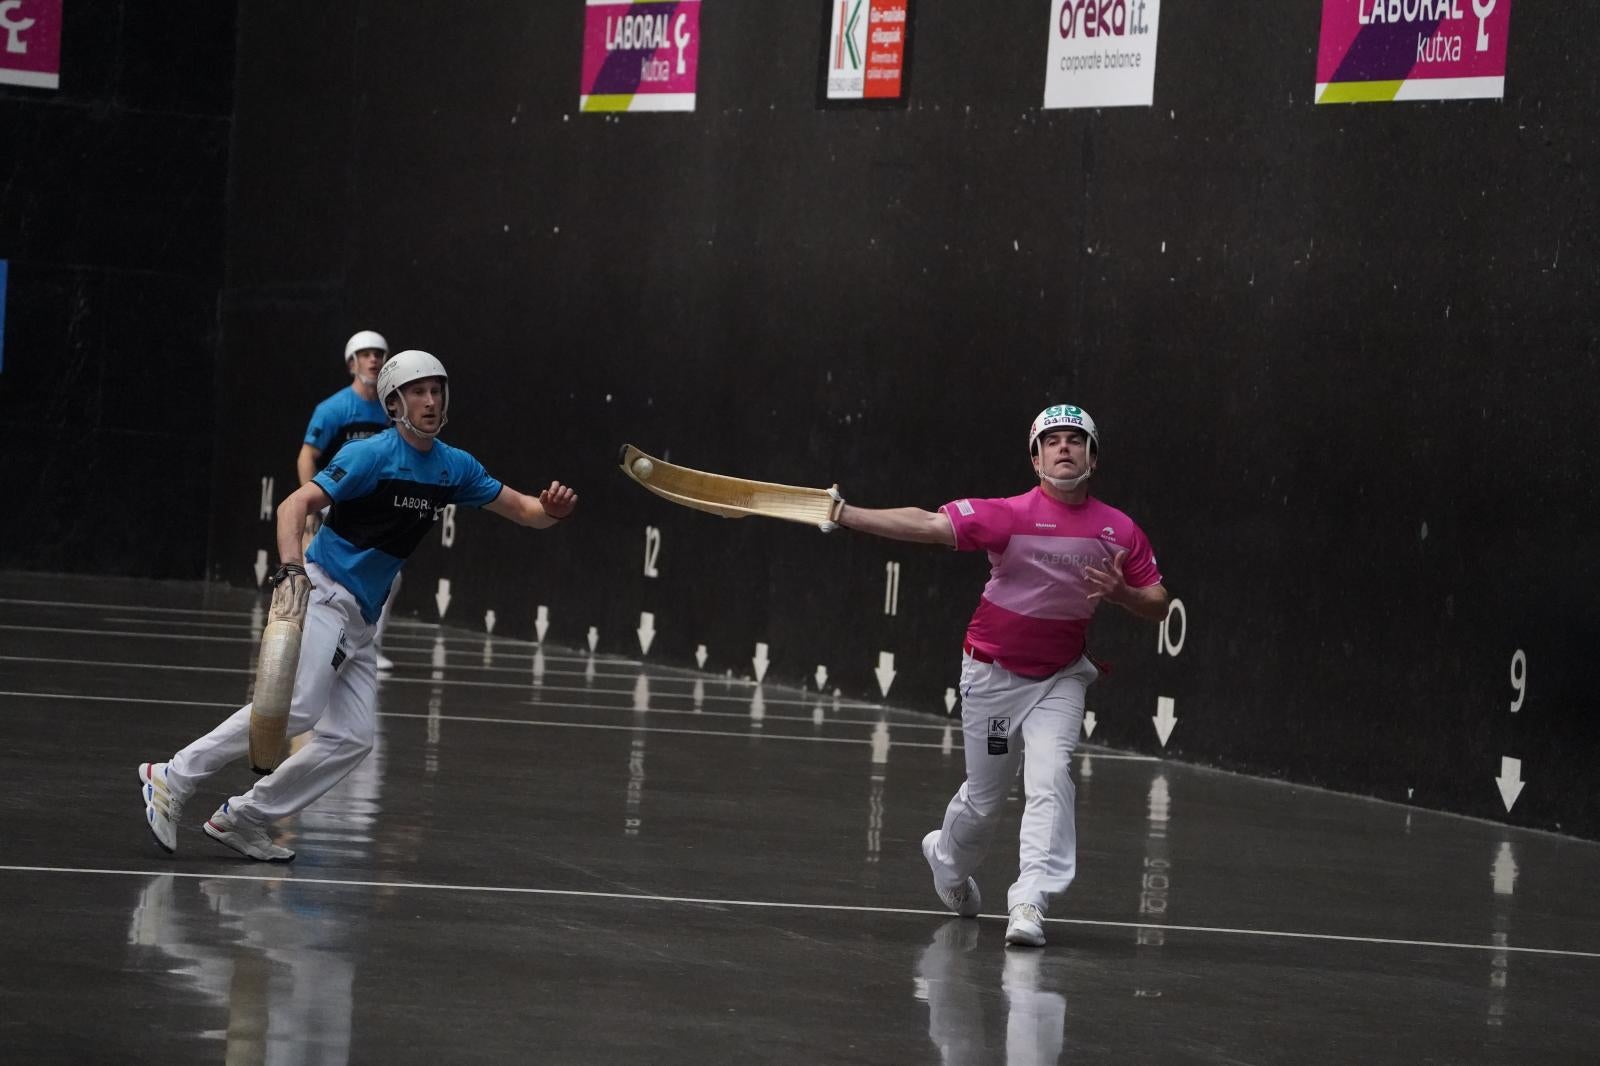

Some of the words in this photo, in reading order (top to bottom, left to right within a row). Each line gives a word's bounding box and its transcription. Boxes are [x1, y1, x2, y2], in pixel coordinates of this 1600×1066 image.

[1358, 0, 1464, 25] LABORAL
[605, 14, 671, 50] LABORAL
[1416, 32, 1462, 63] kutxa
[640, 55, 670, 82] kutxa
[1060, 52, 1102, 76] corporate
[1104, 49, 1142, 69] balance
[643, 525, 660, 579] 12
[885, 560, 900, 617] 11
[1157, 597, 1187, 657] 10
[1510, 647, 1527, 713] 9
